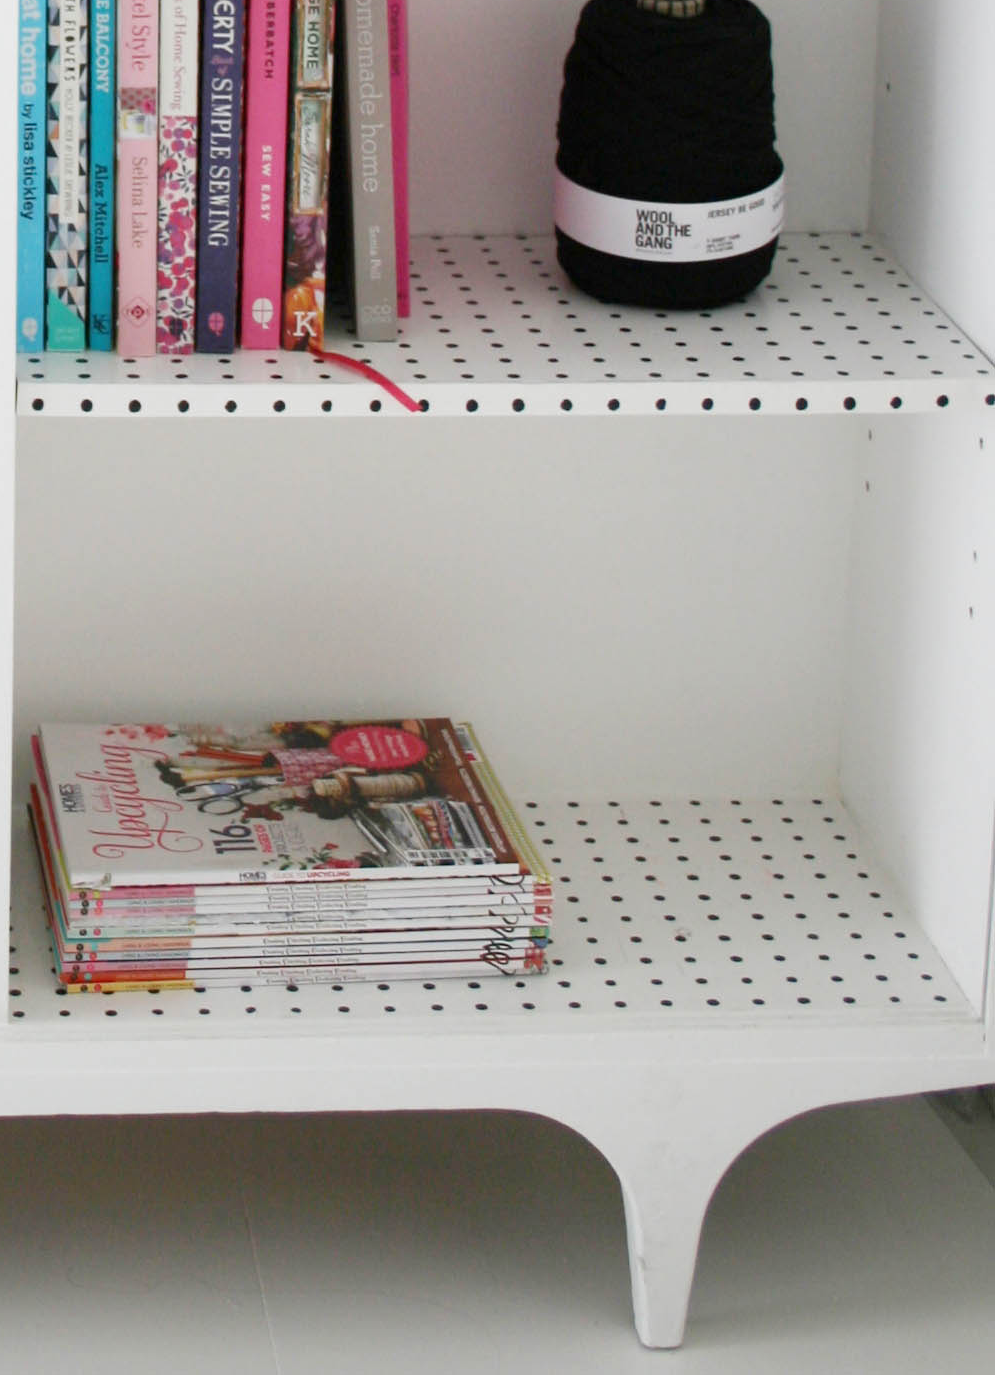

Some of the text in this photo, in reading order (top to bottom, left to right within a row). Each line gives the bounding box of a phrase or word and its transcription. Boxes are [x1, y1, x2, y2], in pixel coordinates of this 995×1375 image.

[173, 22, 187, 63] Home
[174, 6, 187, 21] of
[20, 27, 42, 96] home
[64, 20, 76, 82] FLOWERS
[95, 13, 110, 93] BALCONY
[125, 25, 151, 72] Style
[307, 21, 320, 70] HOME
[171, 65, 186, 111] Sewing
[210, 77, 233, 160] SIMPLE
[20, 103, 37, 221] by lisa stickley
[260, 145, 272, 221] SEW EASY
[360, 124, 383, 193] home
[94, 163, 109, 264] Alex Mitchell
[131, 157, 149, 249] Selina Lake
[207, 165, 231, 247] SEWING
[636, 209, 675, 224] WOOL
[636, 222, 692, 237] AND THE
[635, 235, 673, 250] GANG
[293, 311, 317, 337] K
[76, 743, 203, 859] Upcycling
[208, 824, 258, 856] 116
